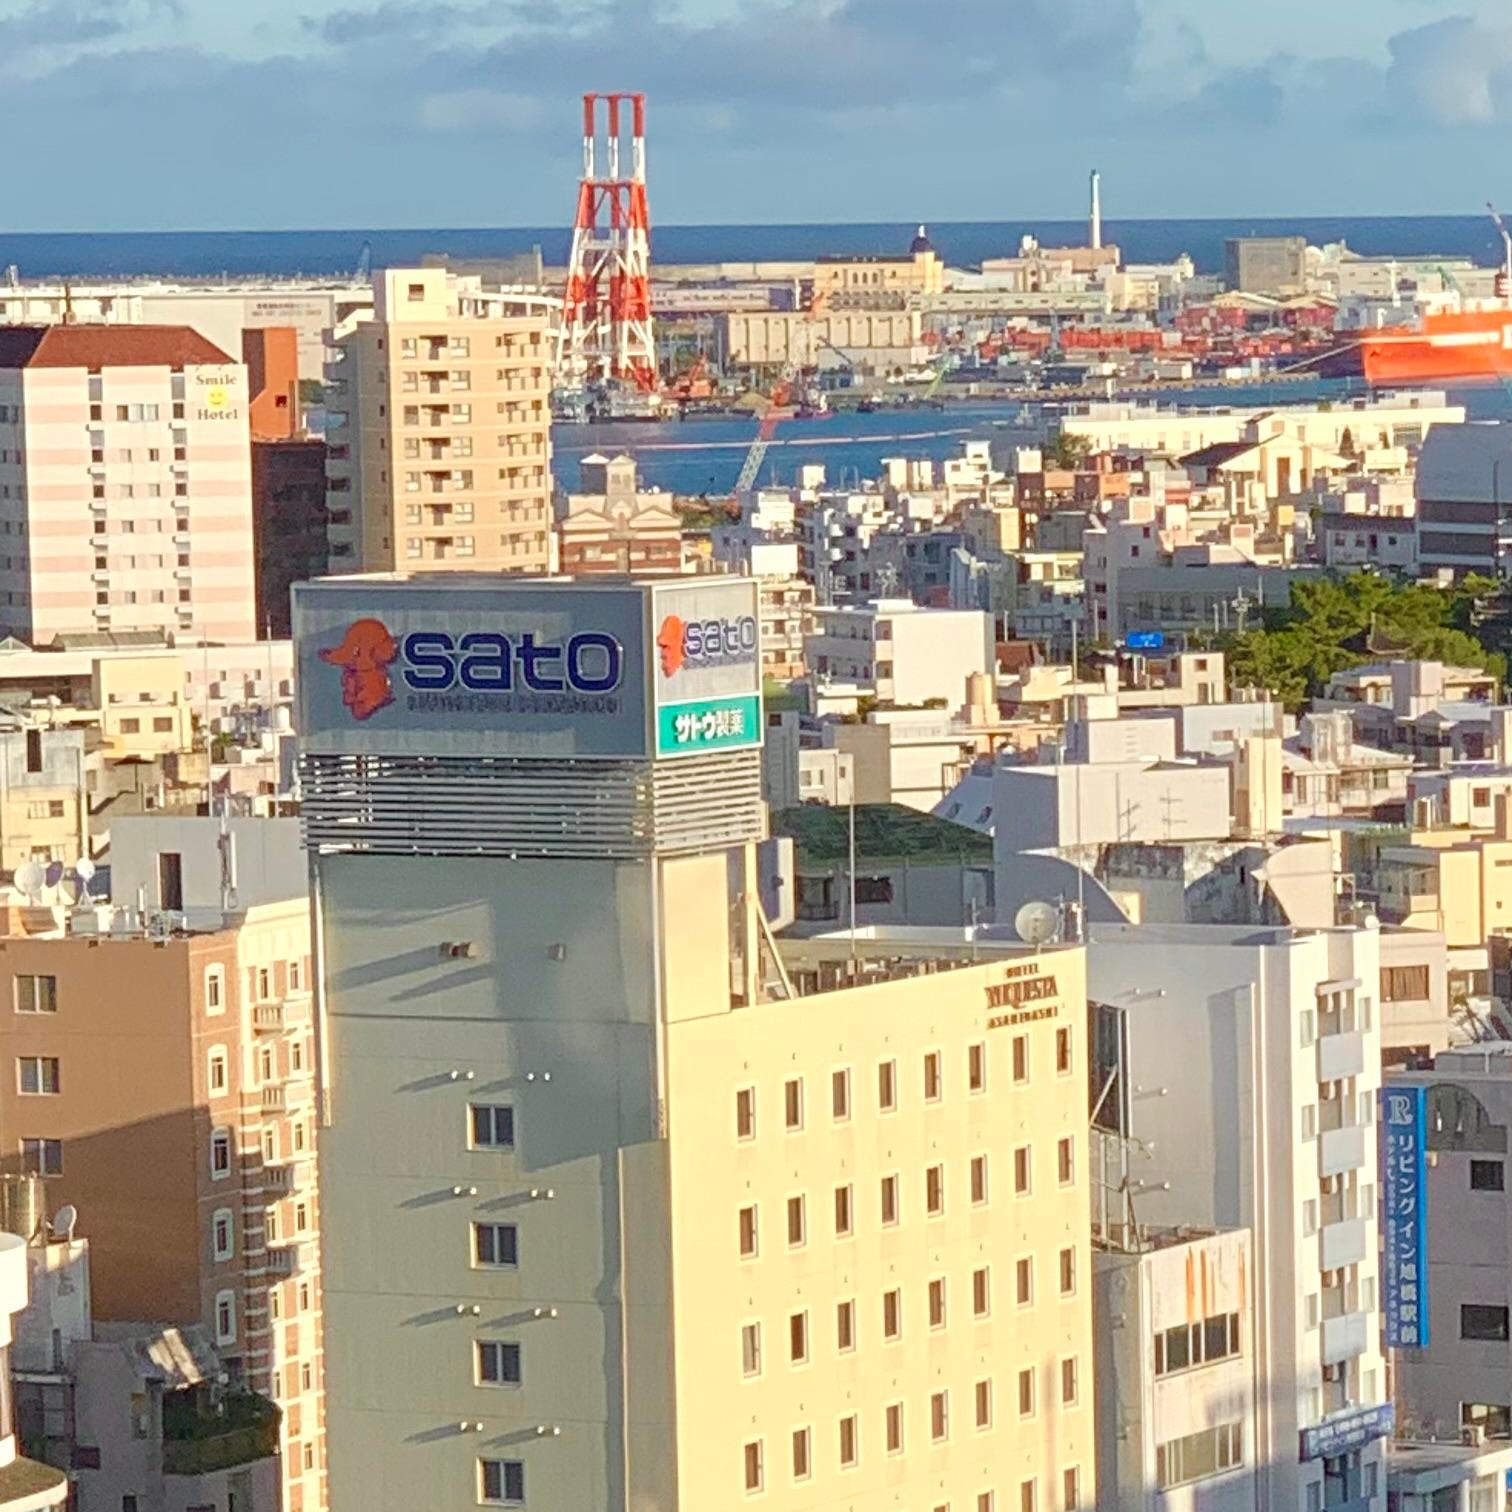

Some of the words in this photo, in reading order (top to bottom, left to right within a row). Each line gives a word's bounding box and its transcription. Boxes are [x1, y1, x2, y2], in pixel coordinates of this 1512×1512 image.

[195, 374, 238, 386] Smile
[197, 408, 238, 420] Hotel
[684, 616, 758, 658] sato
[402, 630, 623, 694] sato
[674, 709, 745, 744] サトウ製薬
